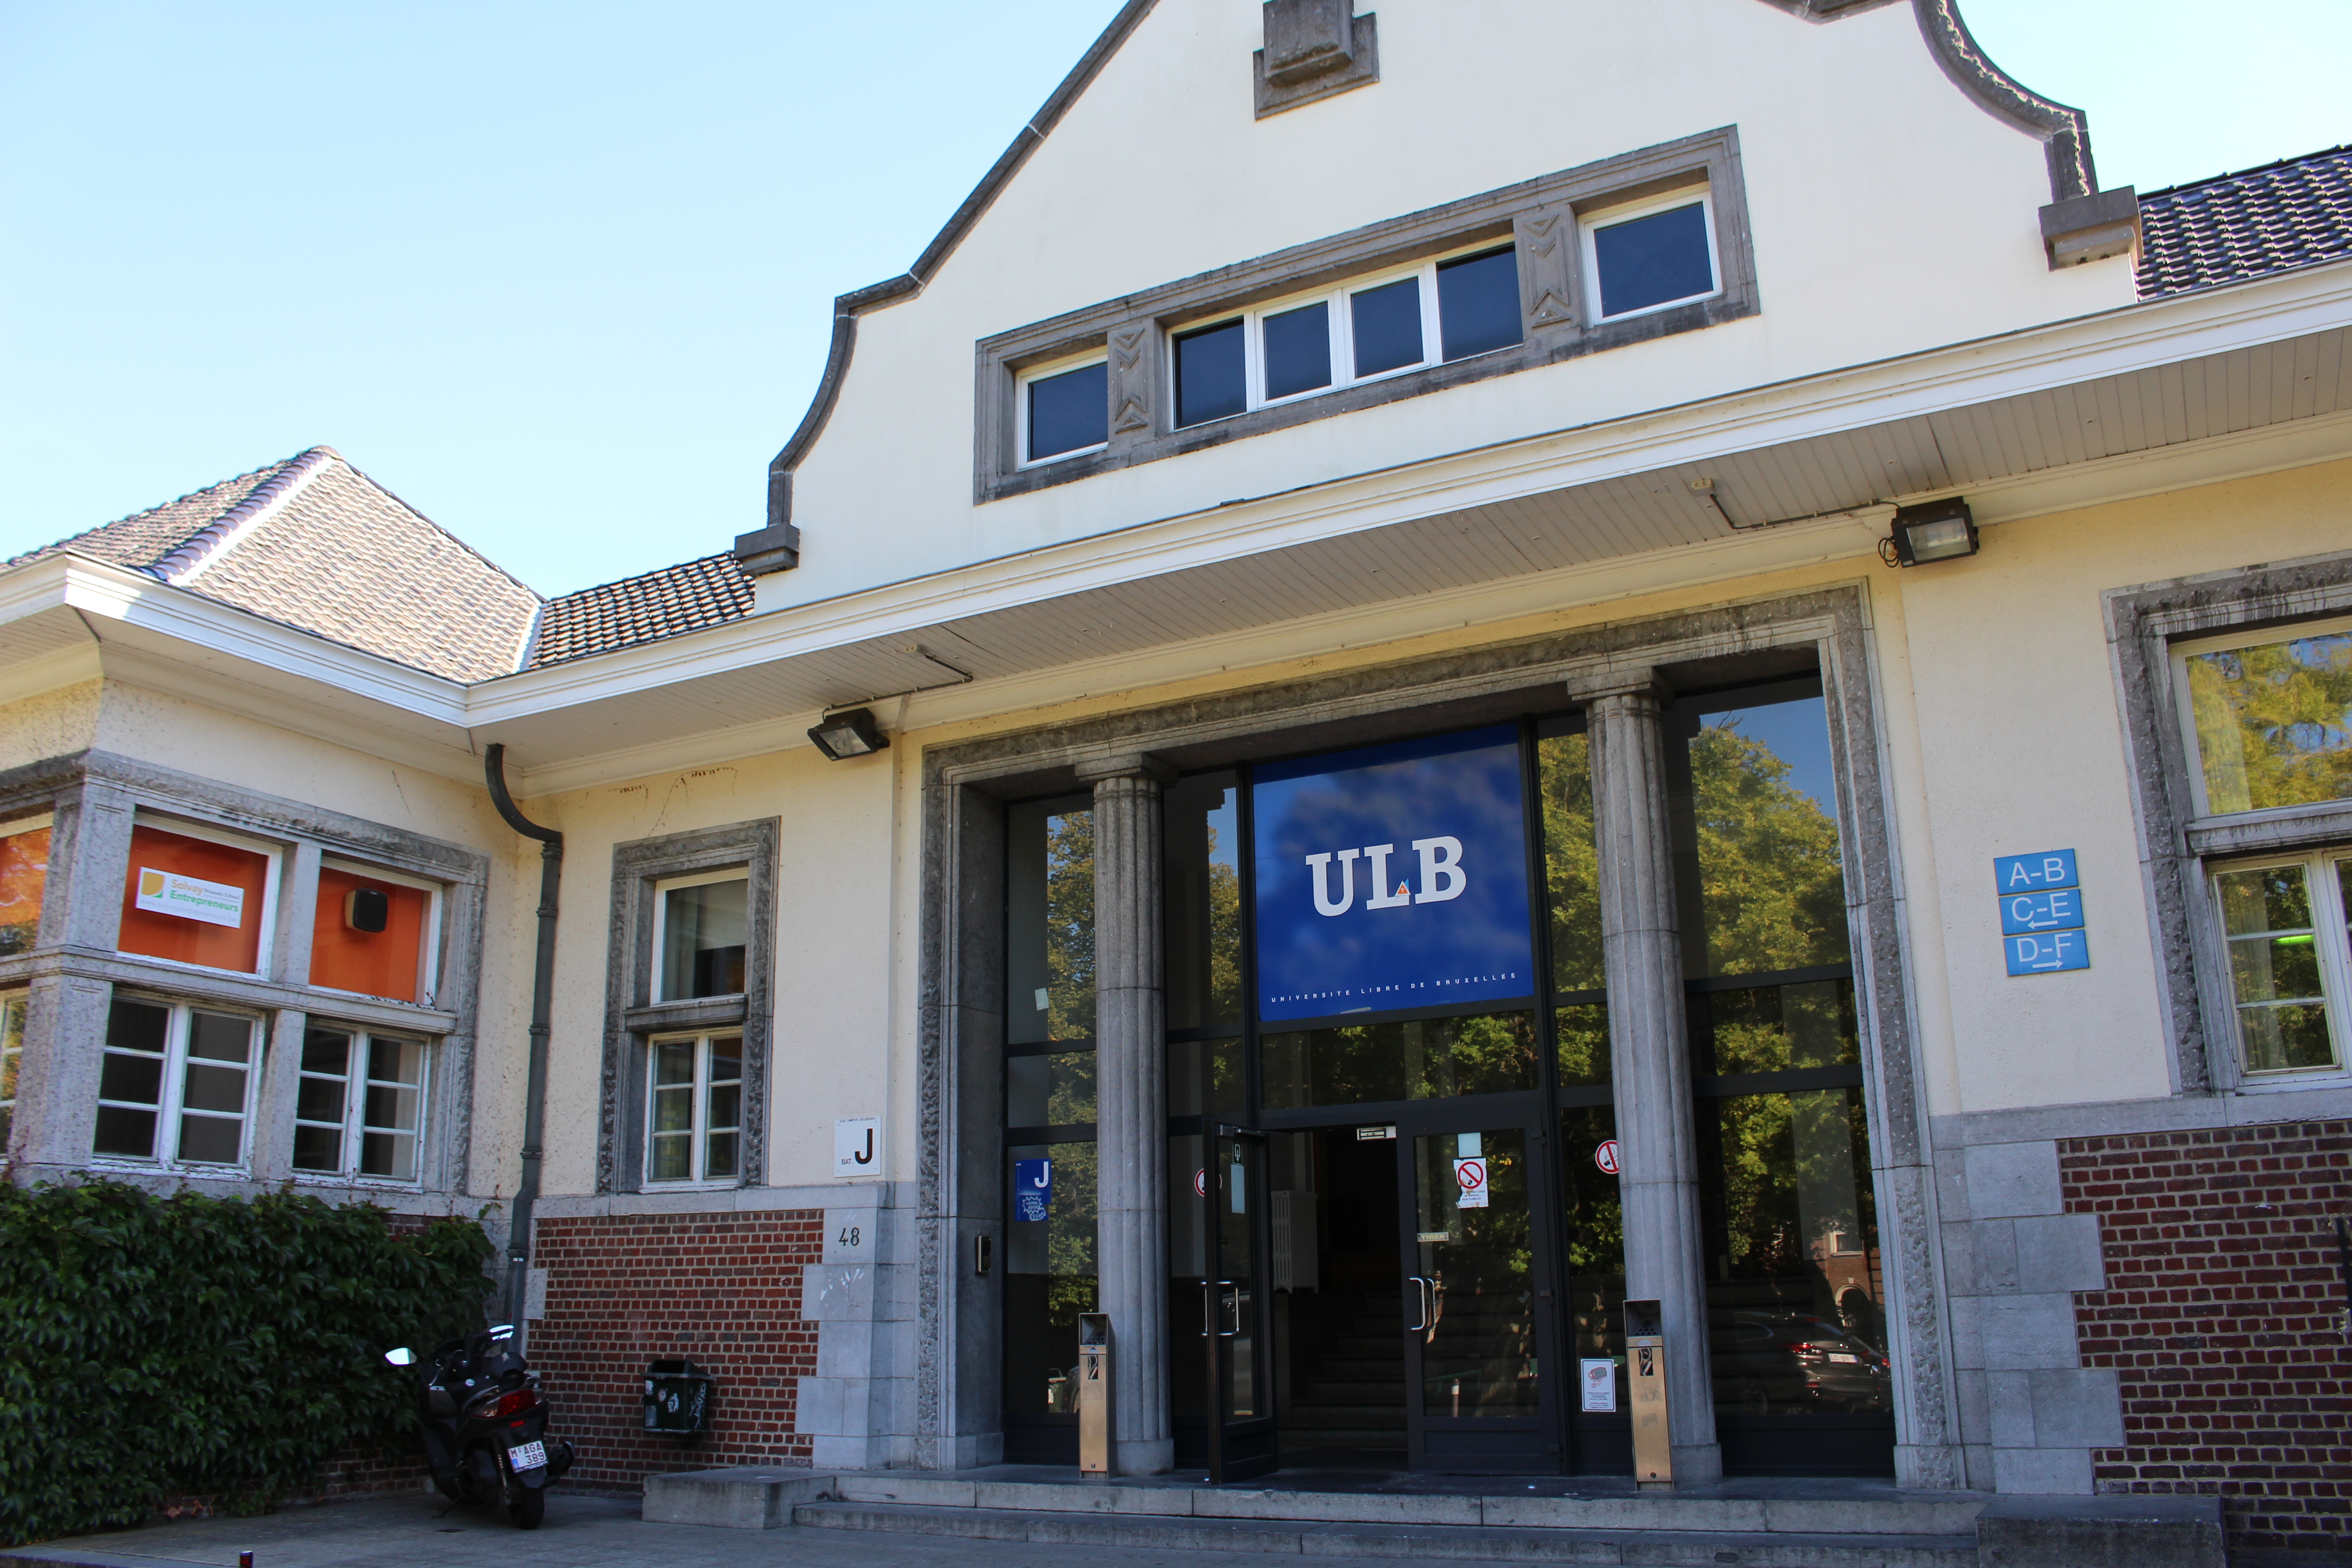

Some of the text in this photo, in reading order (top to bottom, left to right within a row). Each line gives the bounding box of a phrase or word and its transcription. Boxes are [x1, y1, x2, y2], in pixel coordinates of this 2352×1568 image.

[1306, 836, 1466, 916] ULB
[2009, 858, 2065, 887] A-B
[170, 890, 239, 912] Entrepreneurs
[172, 879, 204, 896] Solvay
[2011, 892, 2071, 921] C-E
[2017, 933, 2072, 962] D-F
[1271, 990, 1350, 1003] UNIVERSITE
[1361, 985, 1399, 994] LIBRE
[1436, 973, 1515, 986] BRUXELLES
[855, 1128, 872, 1165] J
[1034, 1161, 1049, 1188] J
[838, 1227, 859, 1246] 48
[510, 1442, 542, 1458] M AGA
[525, 1452, 544, 1464] 389
